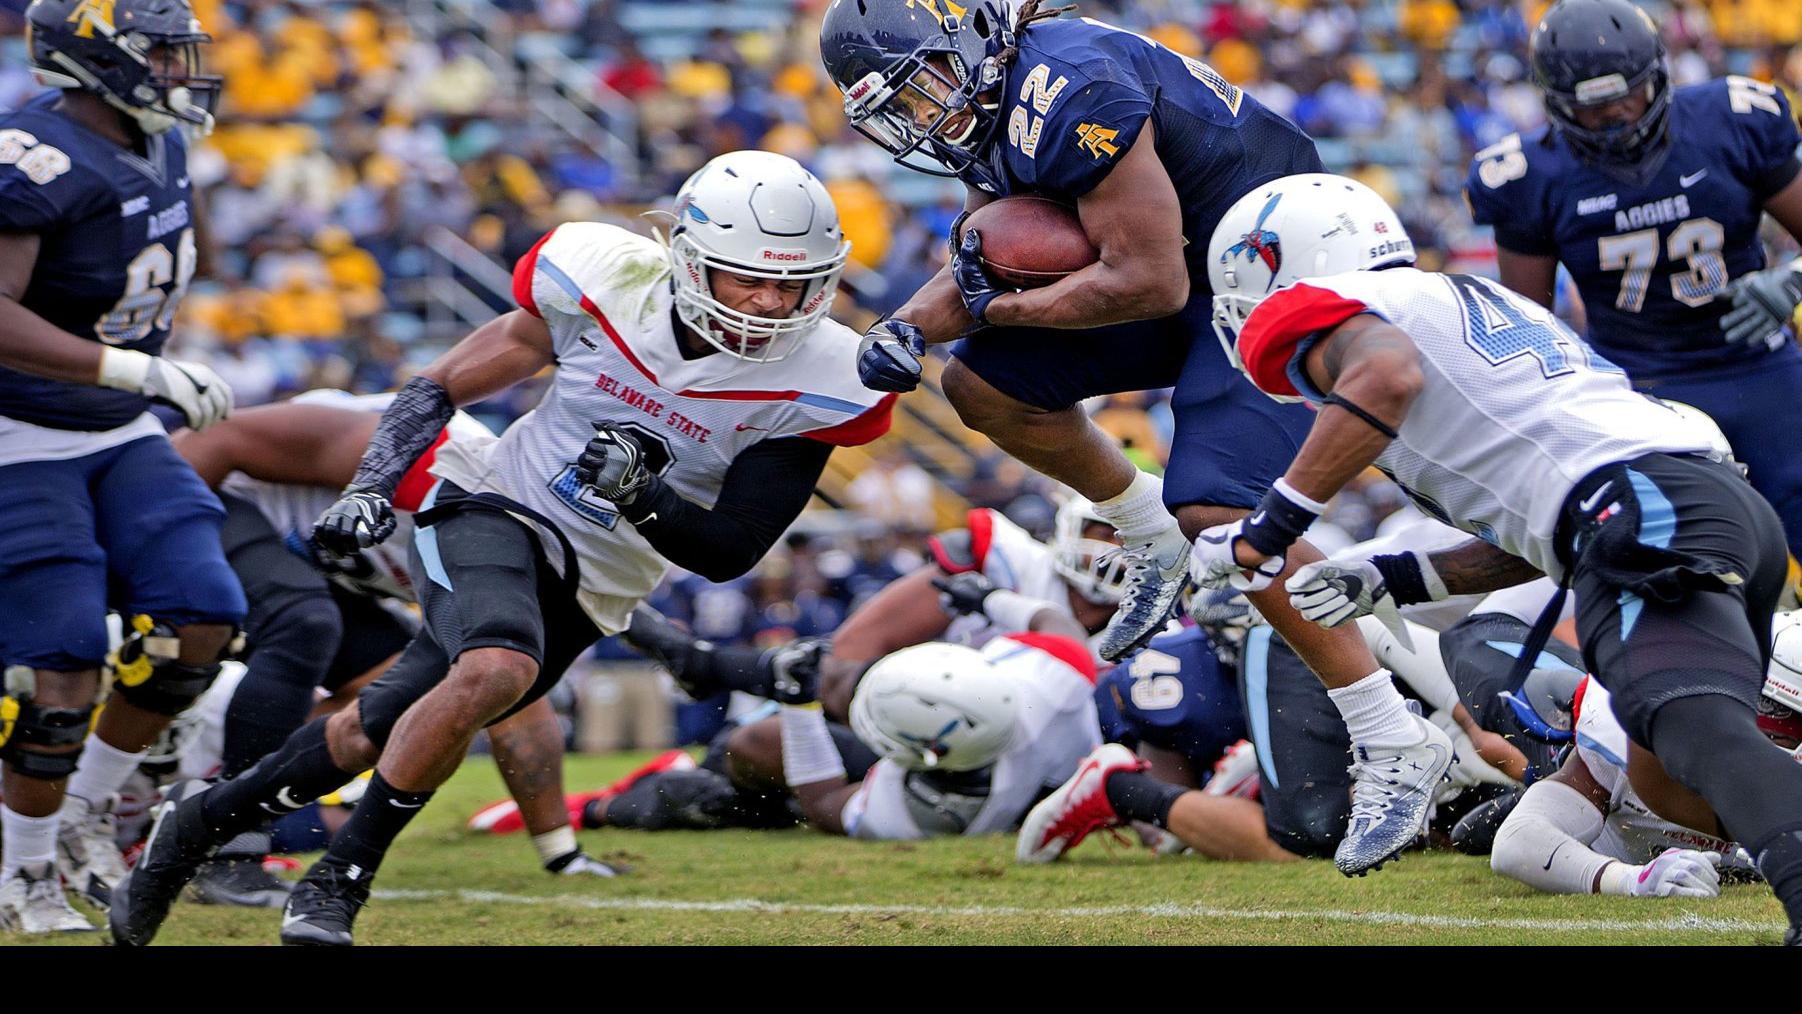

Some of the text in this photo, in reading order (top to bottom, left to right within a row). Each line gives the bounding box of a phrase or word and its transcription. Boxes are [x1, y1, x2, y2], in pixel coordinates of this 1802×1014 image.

[1007, 63, 1070, 160] 22
[763, 250, 807, 262] Riddell
[1598, 216, 1729, 313] 73
[595, 372, 712, 444] DELAWARE STATE
